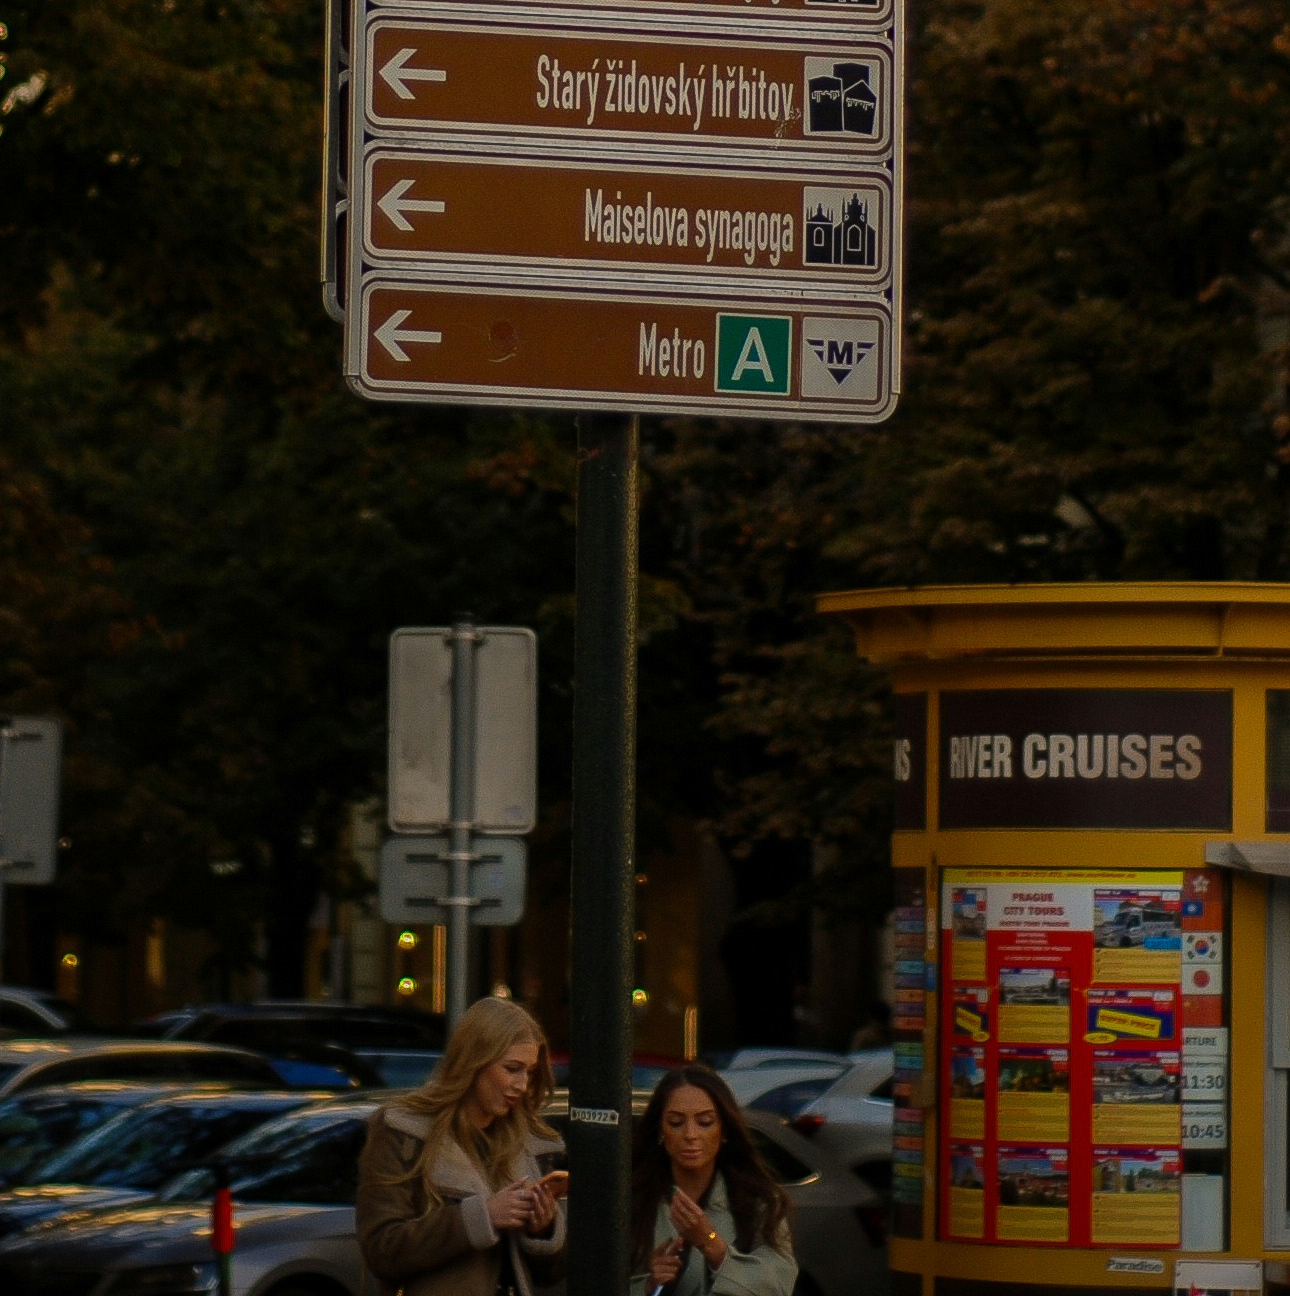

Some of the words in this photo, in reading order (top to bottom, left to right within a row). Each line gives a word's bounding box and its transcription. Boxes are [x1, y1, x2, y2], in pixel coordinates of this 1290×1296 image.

[537, 54, 600, 125] Starý
[605, 59, 707, 131] židovský
[712, 64, 794, 121] hřbitov
[585, 189, 688, 247] Maiselova
[695, 209, 794, 266] synagoga
[639, 322, 705, 378] Metro
[731, 327, 774, 383] A
[828, 341, 853, 365] M
[950, 735, 1012, 779] RIVER
[1024, 733, 1202, 780] CRUISES
[1013, 893, 1054, 902] PRAGUE
[1004, 906, 1025, 916] CITY
[1028, 906, 1064, 916] TOURS
[1182, 1037, 1216, 1046] RTURE
[1181, 1075, 1223, 1089] 11:30
[1181, 1125, 1223, 1139] 10:45
